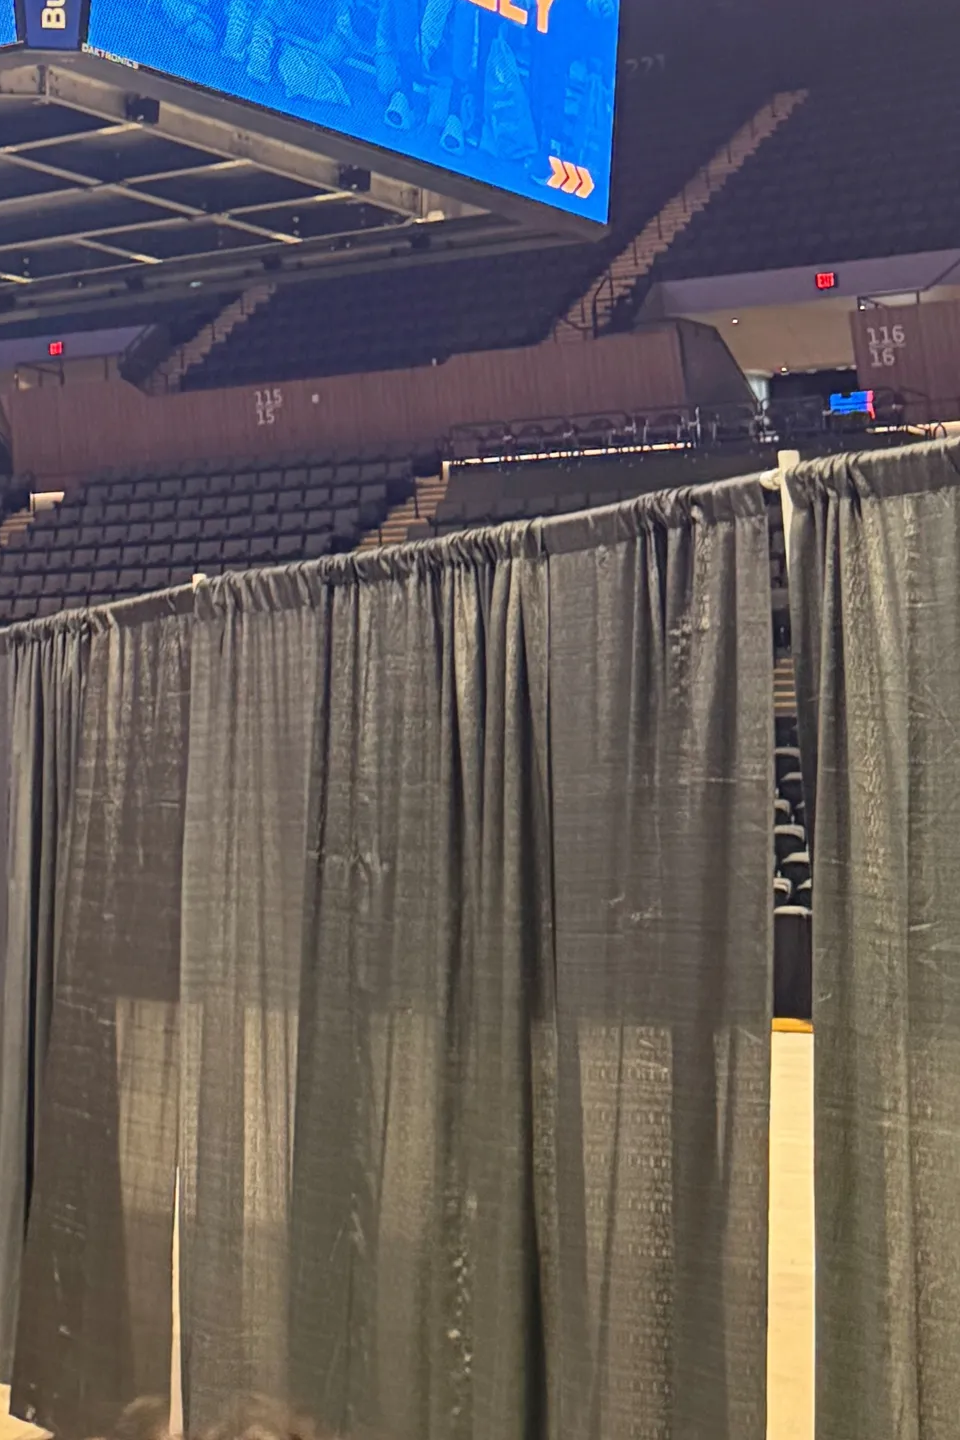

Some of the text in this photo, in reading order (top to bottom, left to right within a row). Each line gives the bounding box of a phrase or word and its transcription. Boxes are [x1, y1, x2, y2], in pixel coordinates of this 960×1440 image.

[866, 324, 906, 345] 116
[869, 348, 896, 367] 16
[254, 389, 283, 406] 115
[256, 408, 275, 425] 15
